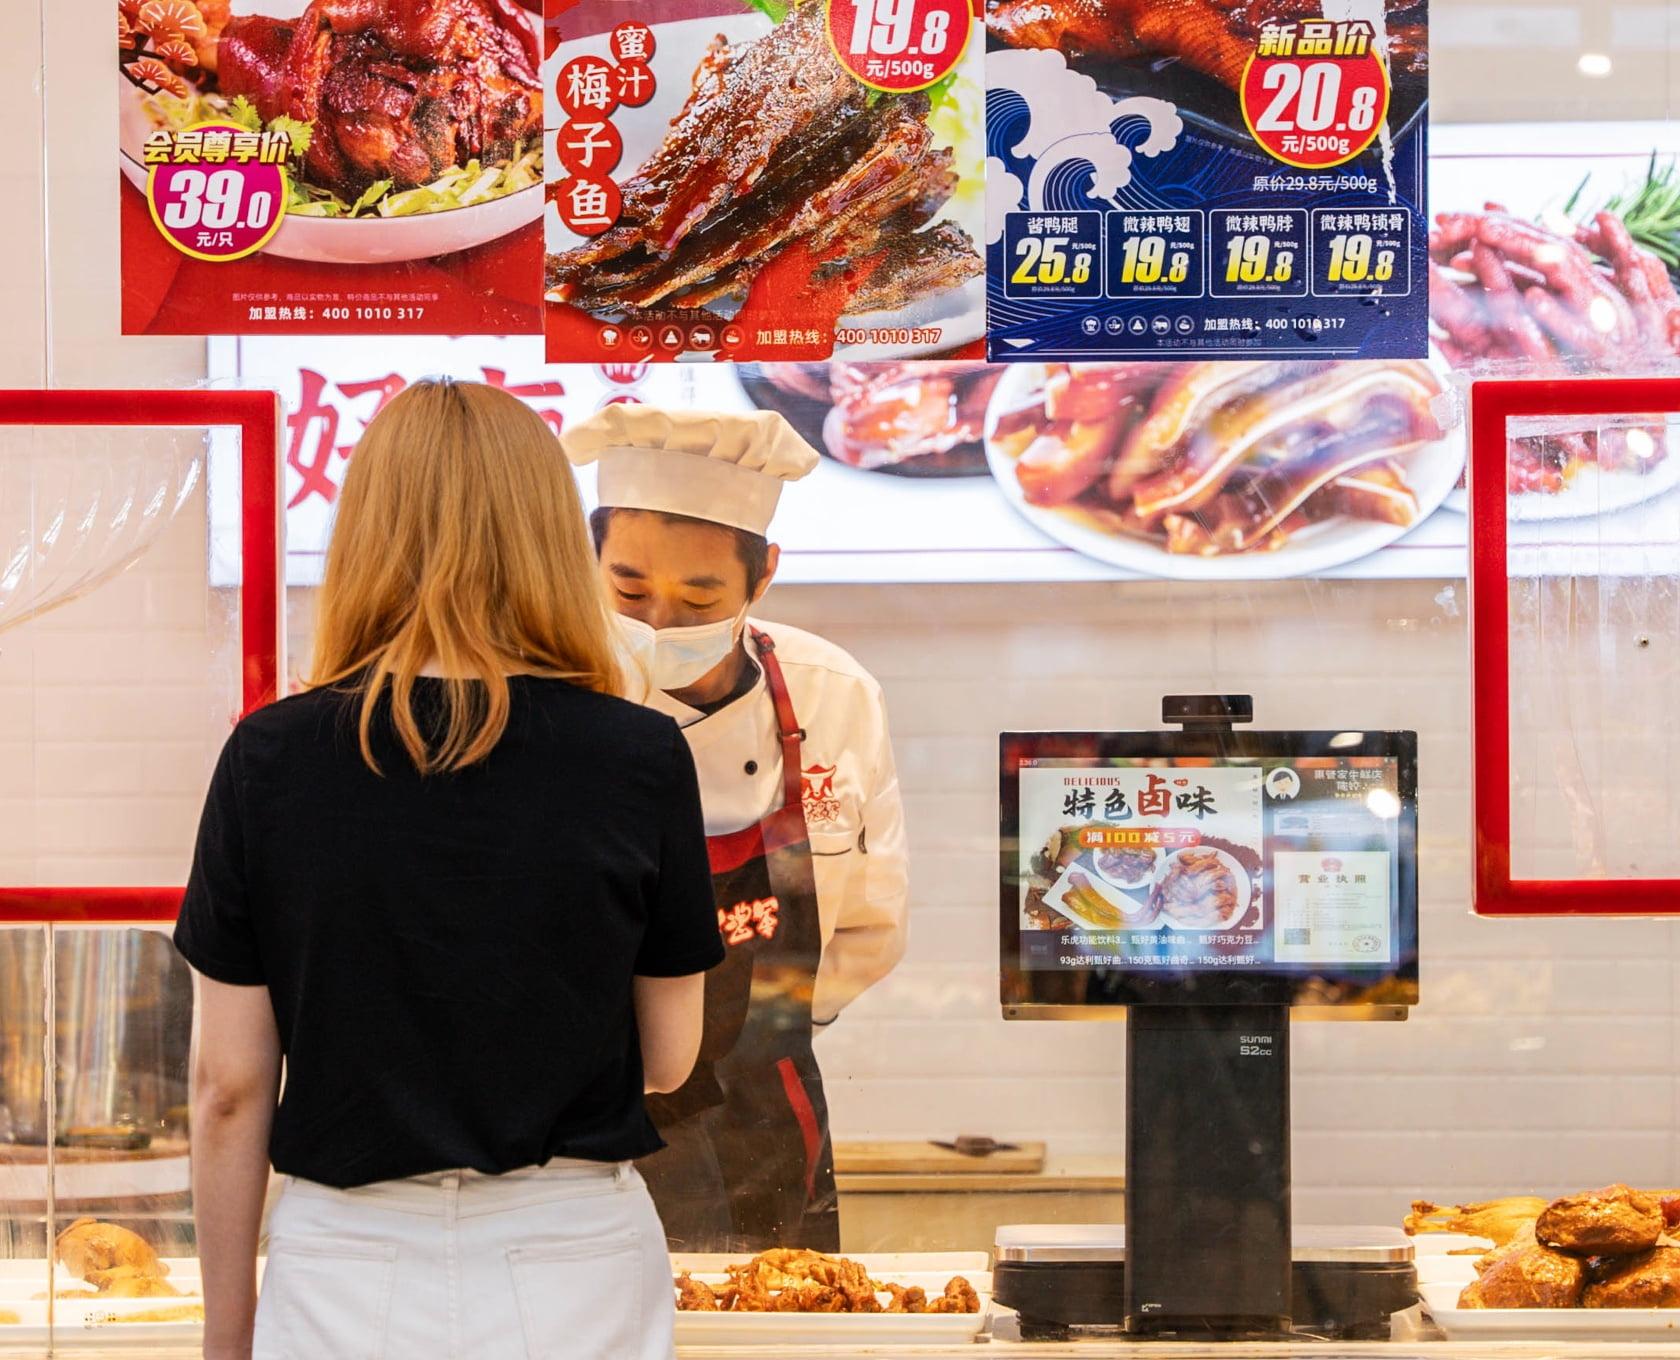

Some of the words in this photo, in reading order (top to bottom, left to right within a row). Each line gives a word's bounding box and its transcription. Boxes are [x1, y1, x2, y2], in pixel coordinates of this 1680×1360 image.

[849, 0, 951, 55] 19.8
[1256, 22, 1372, 57] 新品价
[615, 25, 650, 98] 蜜汁
[866, 59, 935, 79] 元/500g
[1255, 62, 1378, 132] 20.8
[143, 130, 291, 165] 会员尊享价
[566, 63, 613, 226] 梅子鱼
[1281, 135, 1350, 155] 元/500g
[1252, 175, 1378, 193] 原价29.8元/500g
[163, 169, 272, 229] 39.0
[1027, 216, 1079, 234] 酱鸭腿
[1123, 215, 1191, 233] 微辣鸭翅
[1226, 214, 1294, 232] 微辣鸭脖
[1320, 213, 1405, 232] 微辣鸭锁骨
[196, 231, 234, 247] 元/只
[1011, 237, 1092, 284] 25.8
[1121, 236, 1189, 284] 19.8
[1225, 235, 1294, 283] 19.8
[1328, 234, 1395, 282] 19.8
[322, 307, 350, 320] 400
[355, 307, 392, 320] 1010
[397, 307, 425, 320] 317
[1265, 318, 1288, 330] 400
[1323, 318, 1346, 330] 317
[836, 328, 867, 344] 400
[871, 328, 909, 344] 1010
[911, 328, 942, 344] 317
[1064, 777, 1120, 786] DELICIOUS
[1062, 774, 1218, 821] 特色卤味
